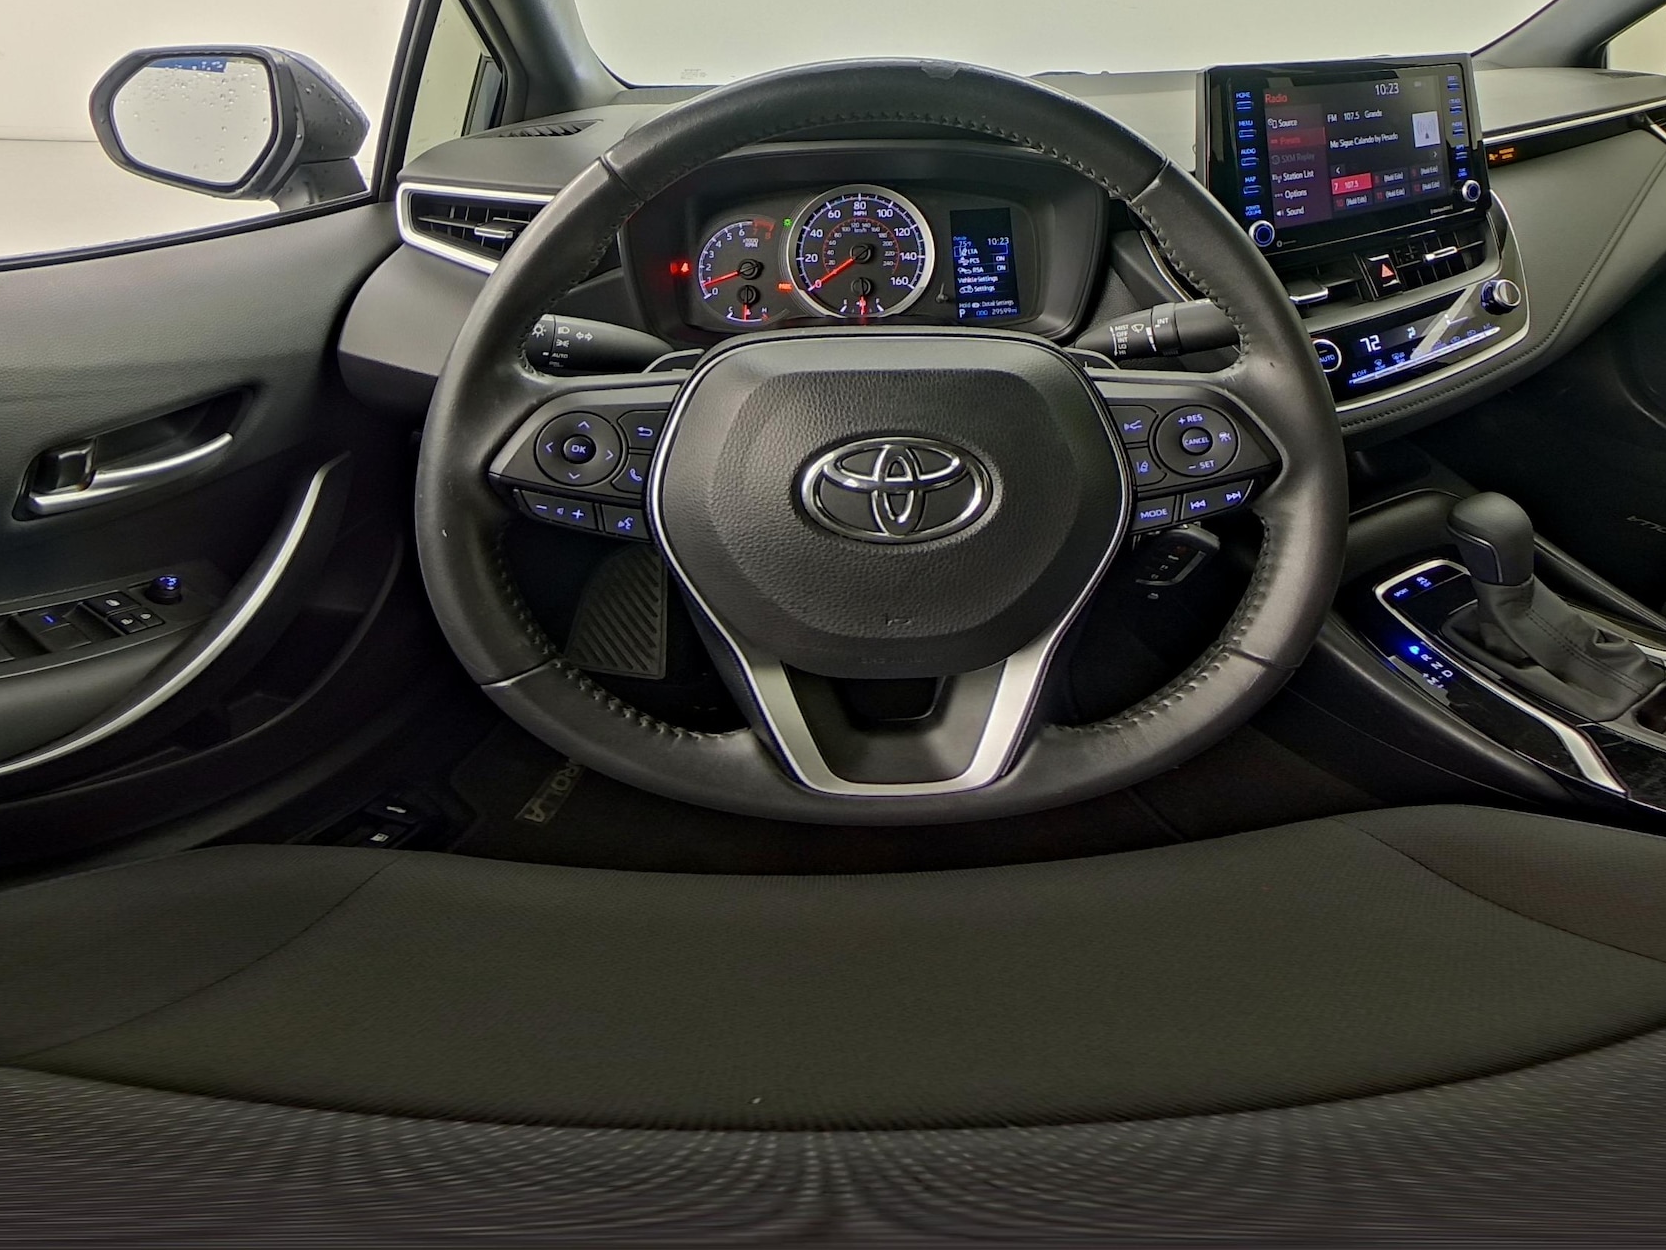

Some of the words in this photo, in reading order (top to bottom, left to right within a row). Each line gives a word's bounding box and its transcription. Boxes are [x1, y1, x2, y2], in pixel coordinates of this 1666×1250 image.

[1375, 83, 1399, 95] 10:23
[1265, 94, 1287, 103] Radio
[1327, 114, 1337, 122] FM
[1344, 112, 1360, 121] 107.5
[1364, 110, 1382, 118] Grande
[1278, 119, 1298, 127] Source
[1283, 172, 1303, 181] Station
[1284, 189, 1307, 199] Options
[853, 202, 866, 210] 80
[828, 210, 841, 218] 60
[877, 209, 893, 217] 100
[1286, 206, 1304, 216] Sound
[810, 229, 823, 238] 40
[894, 228, 910, 236] 120
[988, 237, 1009, 246] 10:23
[805, 254, 818, 262] 20
[900, 252, 917, 260] 140
[815, 280, 821, 288] 0
[891, 277, 908, 285] 160
[959, 309, 965, 318] P
[1359, 334, 1381, 353] 72
[1319, 355, 1335, 363] AUTO
[1184, 436, 1210, 446] CANCEL
[571, 444, 587, 454] OK
[1199, 460, 1215, 469] SET
[1140, 508, 1168, 519] MODE
[1431, 662, 1443, 670] N
[1442, 670, 1453, 678] D
